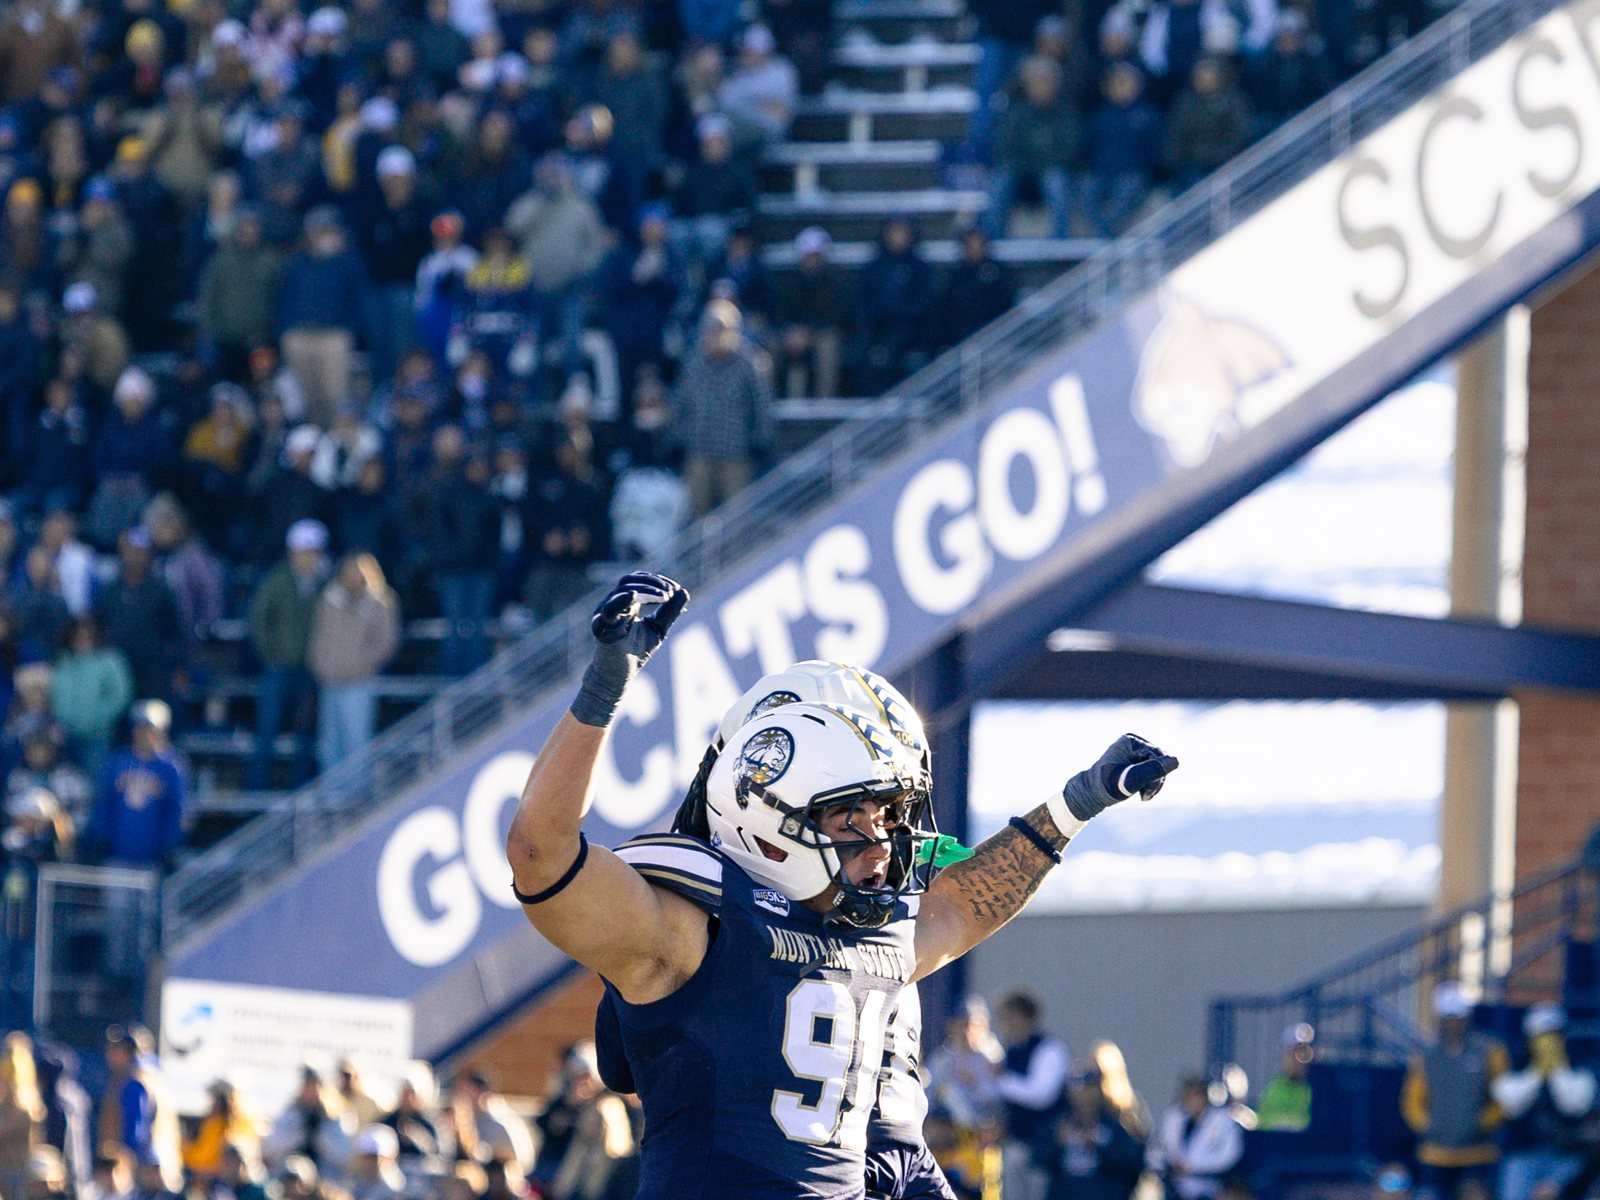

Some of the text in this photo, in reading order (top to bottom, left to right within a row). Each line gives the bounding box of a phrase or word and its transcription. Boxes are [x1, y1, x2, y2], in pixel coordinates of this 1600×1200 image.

[377, 373, 1108, 967] GO CATS GO!
[766, 925, 911, 983] MONTANA STATE
